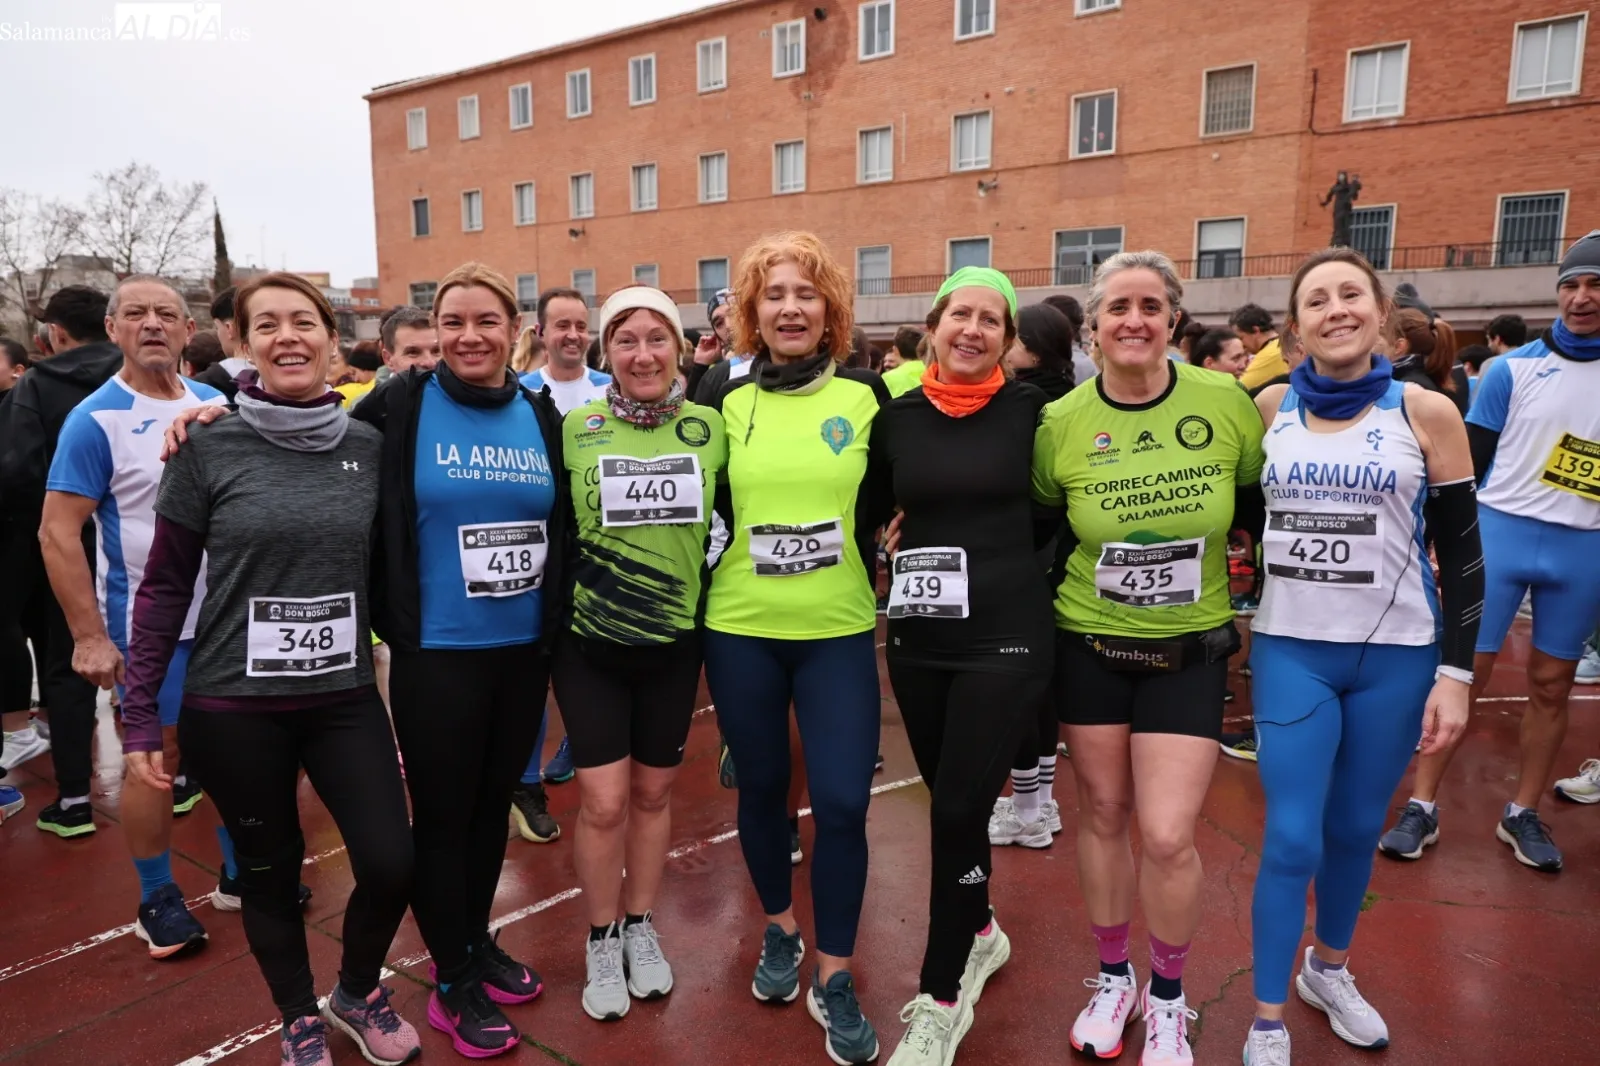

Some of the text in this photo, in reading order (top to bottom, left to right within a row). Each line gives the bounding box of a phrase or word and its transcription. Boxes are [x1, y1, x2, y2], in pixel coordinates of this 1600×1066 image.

[436, 443, 551, 475] LA ARMUÑA
[1085, 448, 1120, 458] CARBAJOSA
[448, 468, 549, 486] CLUB DEPORTIVO
[629, 464, 672, 472] DON BOSCO
[1084, 464, 1221, 495] CORRECAMINOS
[1287, 461, 1397, 494] ARMUÑA
[625, 479, 677, 503] 440
[1100, 483, 1213, 511] CARBAJOSA
[1271, 488, 1383, 505] CLUB DEPORTIVO
[1118, 502, 1204, 523] SALAMANCA
[507, 533, 528, 541] BOSCO
[487, 549, 532, 574] 418
[1147, 552, 1172, 560] BOSCO
[1288, 538, 1350, 564] 420
[902, 576, 941, 598] 439
[1120, 566, 1173, 591] 435
[306, 608, 330, 618] BOSCO
[278, 626, 334, 652] 348
